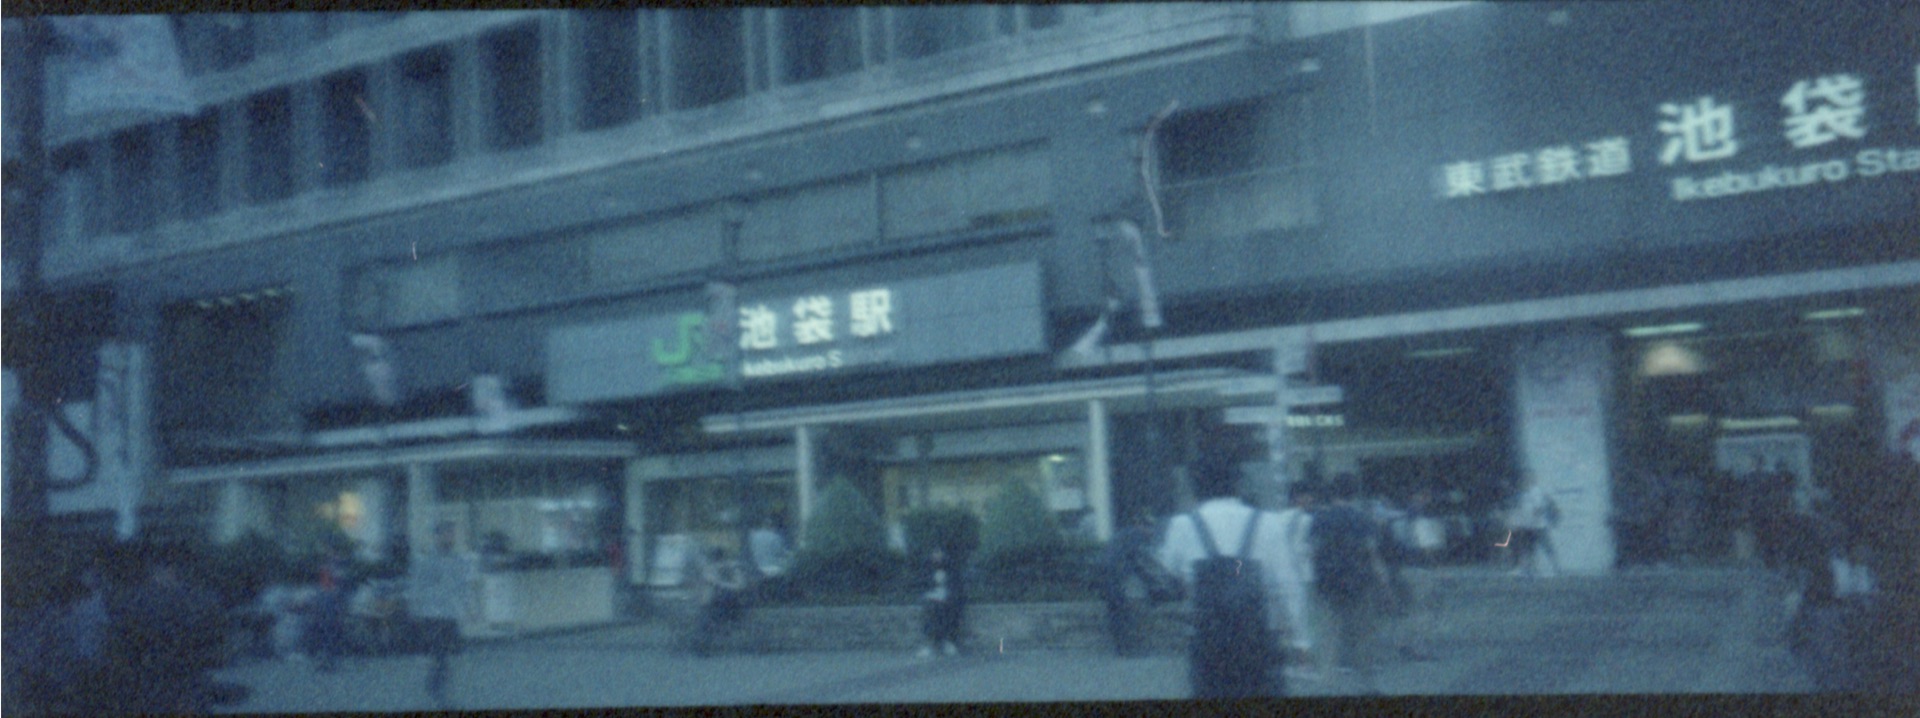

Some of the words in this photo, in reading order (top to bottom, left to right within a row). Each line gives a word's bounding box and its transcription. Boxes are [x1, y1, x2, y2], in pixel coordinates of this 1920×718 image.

[1444, 138, 1631, 197] 東武鉄道
[1672, 159, 1848, 201] Ikebukuro
[739, 288, 893, 350] 池袋駅
